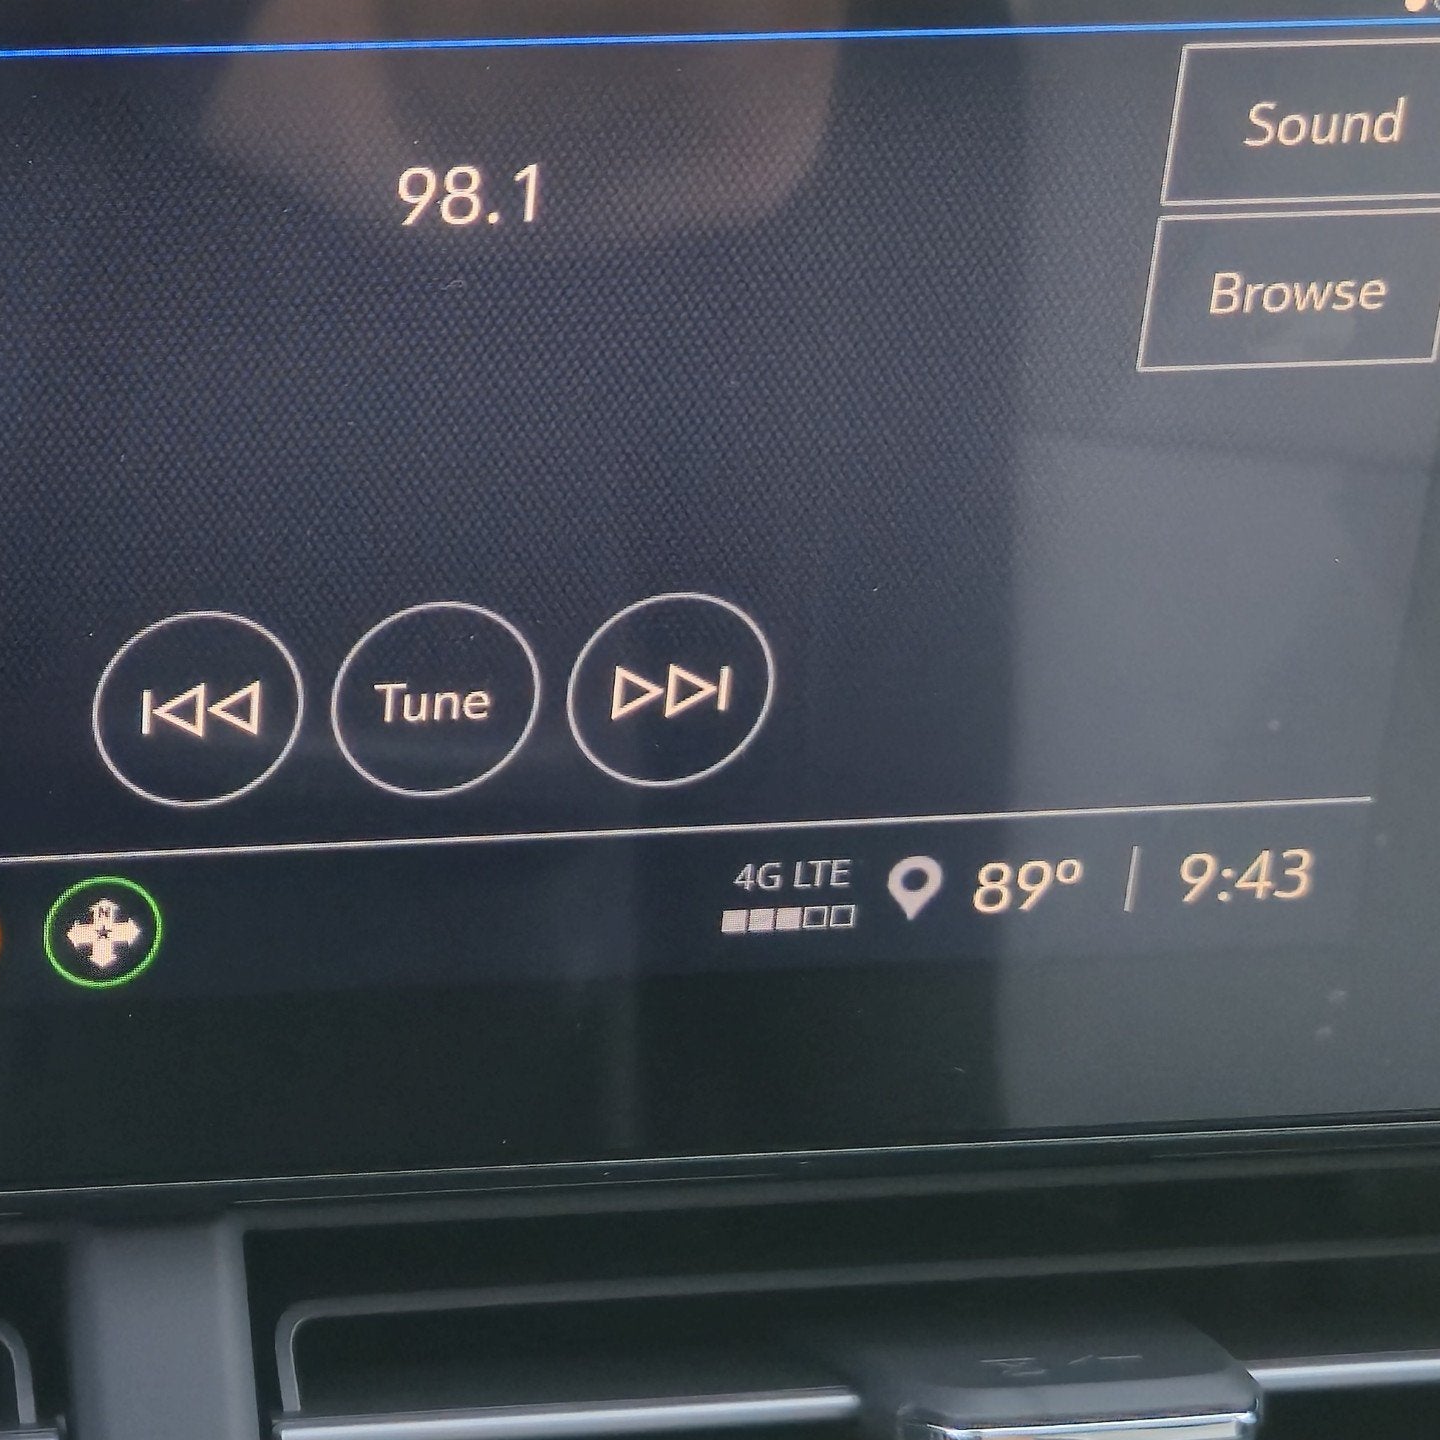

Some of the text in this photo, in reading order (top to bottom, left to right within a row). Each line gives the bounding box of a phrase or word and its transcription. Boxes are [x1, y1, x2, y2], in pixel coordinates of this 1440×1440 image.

[1242, 95, 1408, 148] Sound
[396, 162, 540, 227] 98.1
[1208, 270, 1389, 316] Browse
[372, 681, 493, 724] Tune
[732, 857, 852, 892] 4G LTE
[1179, 847, 1314, 904] 9:43
